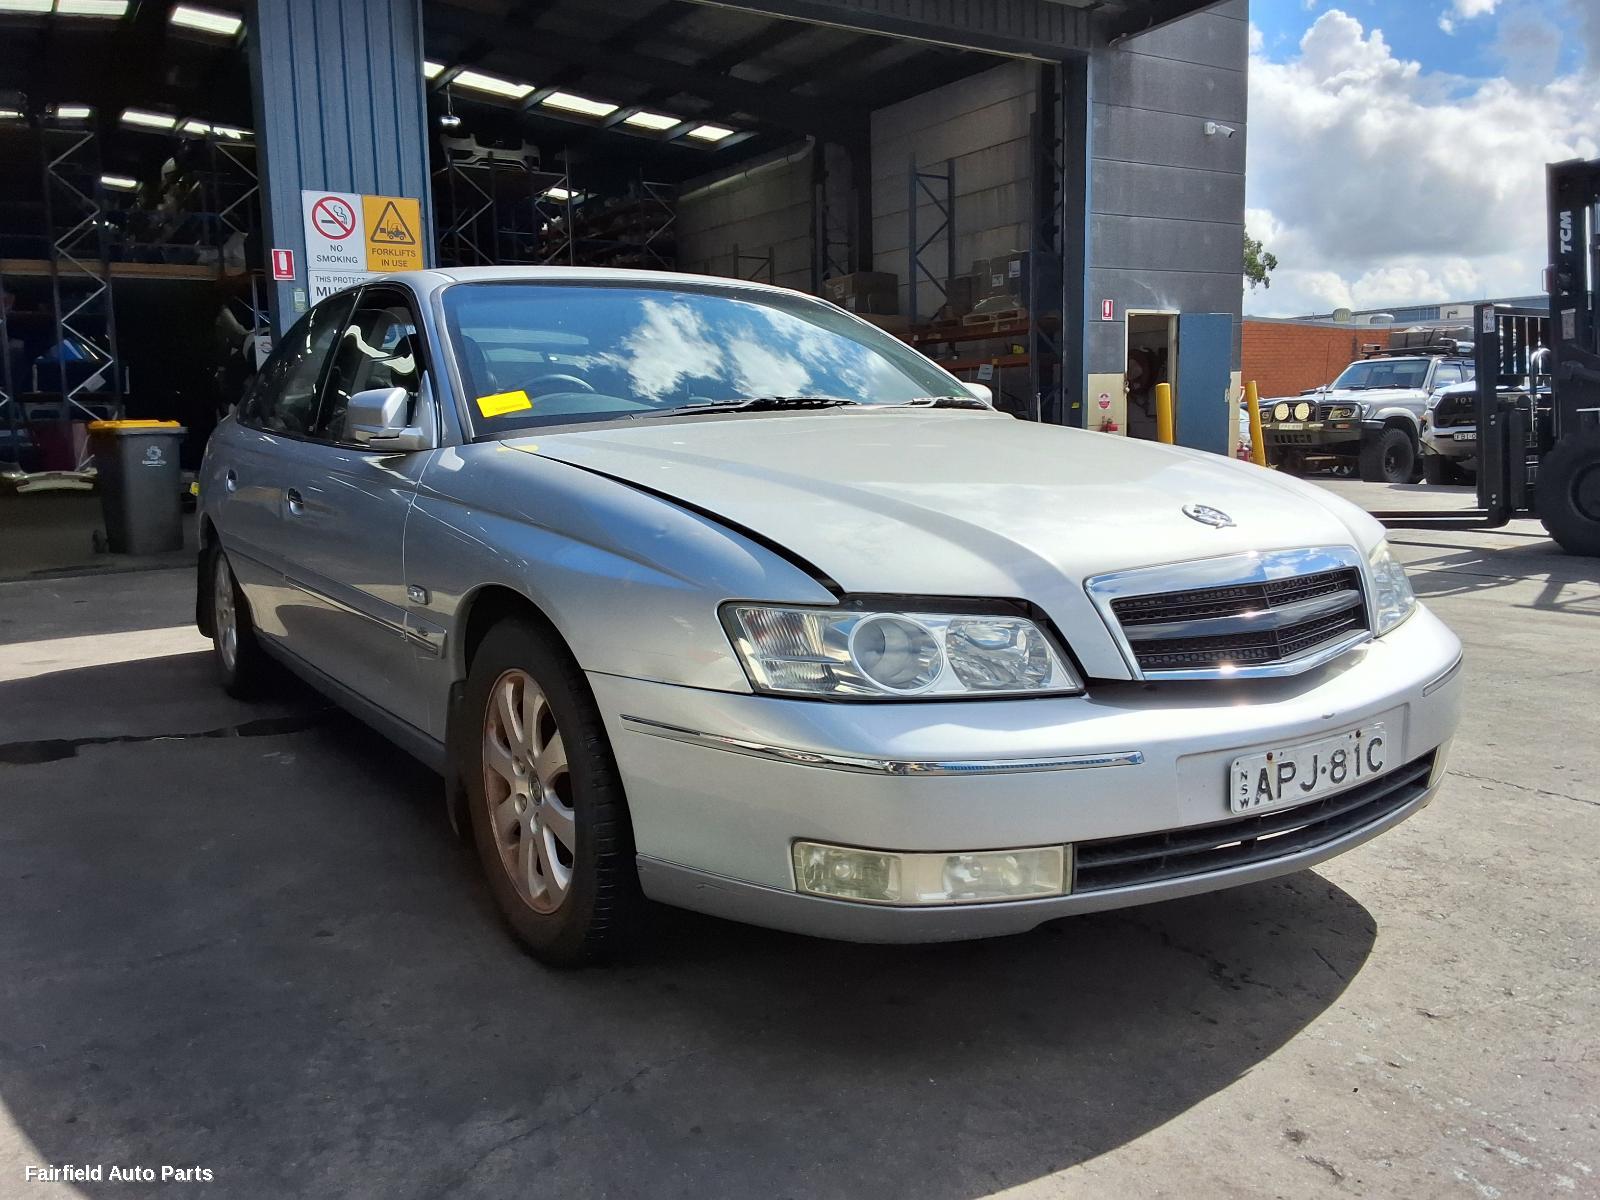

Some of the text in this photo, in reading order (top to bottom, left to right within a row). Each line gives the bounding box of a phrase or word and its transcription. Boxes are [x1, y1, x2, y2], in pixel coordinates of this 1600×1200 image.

[1560, 210, 1572, 254] TCM
[330, 244, 343, 252] NO
[371, 247, 416, 257] FORKLIFTS
[316, 254, 358, 264] SMOKING
[381, 259, 390, 267] IN
[315, 275, 331, 283] THIS
[1239, 770, 1250, 809] NSW
